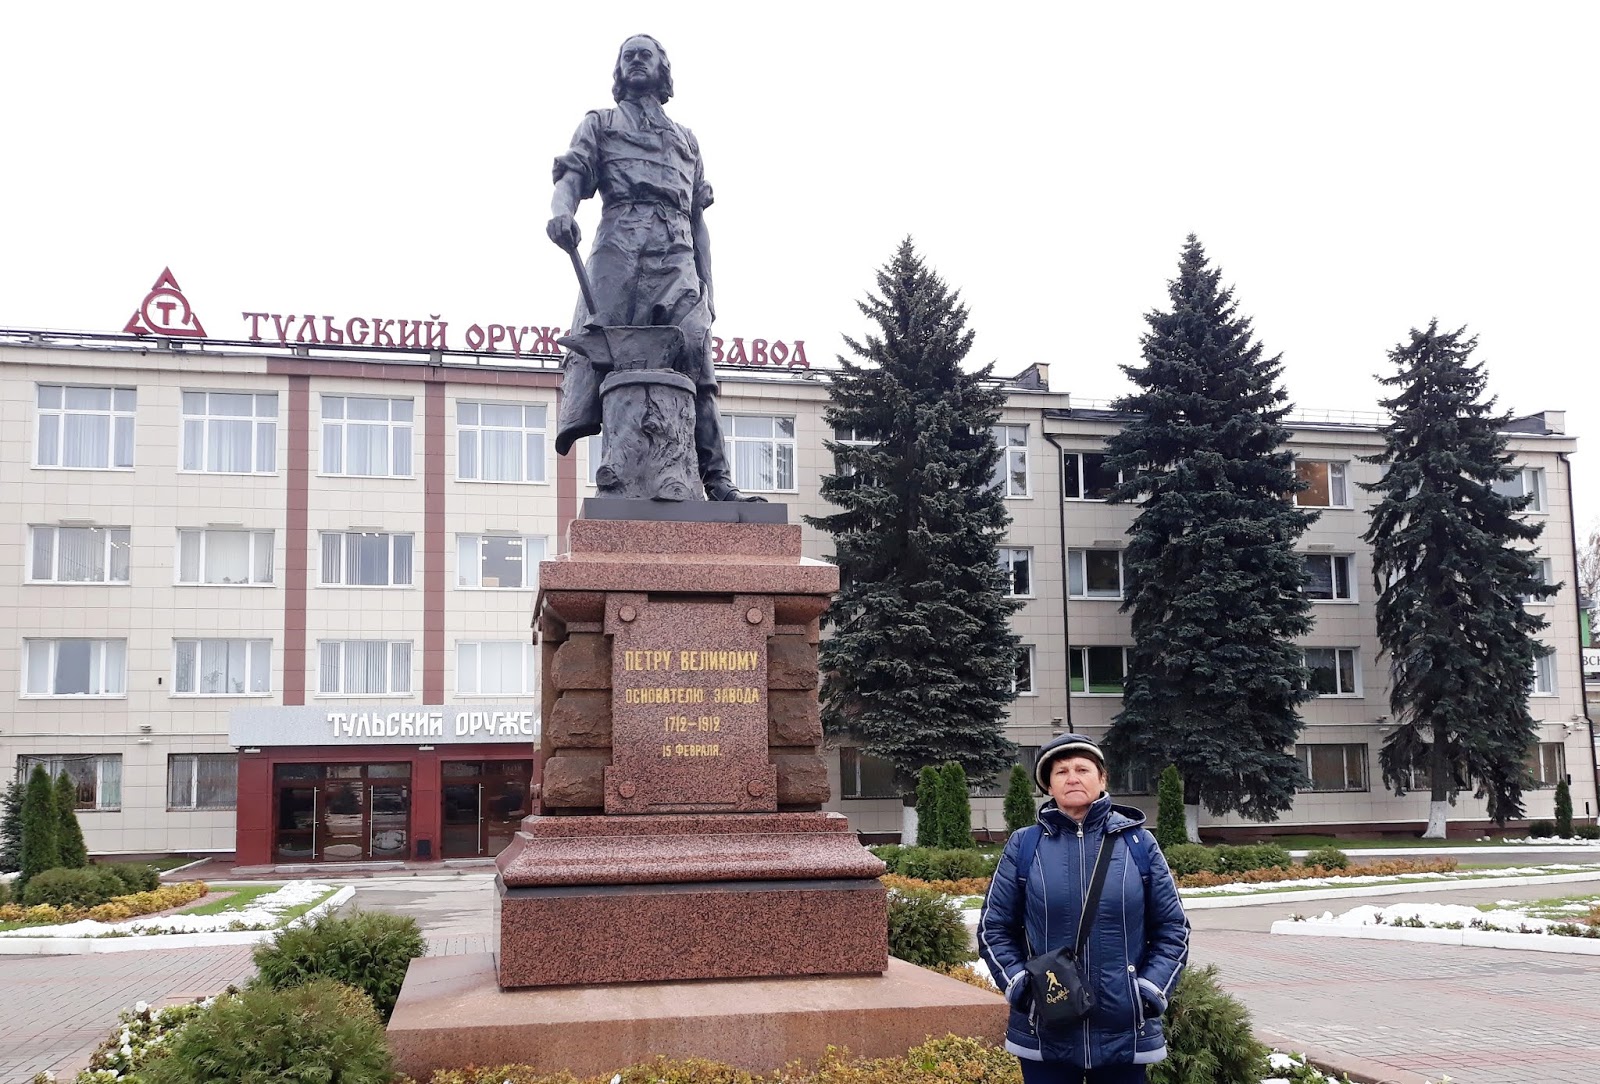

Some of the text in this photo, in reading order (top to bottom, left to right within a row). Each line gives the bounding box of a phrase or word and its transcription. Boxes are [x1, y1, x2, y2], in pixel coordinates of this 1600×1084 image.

[241, 311, 810, 371] ТУЛЬСКИЙ ОРУЖ ЗАВОД
[624, 650, 758, 671] ПЕТРУ ВЕЛИКОМУ
[625, 687, 760, 705] ОСНОВАТЕЛЮ ЗАВОДА
[327, 711, 444, 738] ТУЛЬСКИЙ
[662, 744, 672, 757] 15
